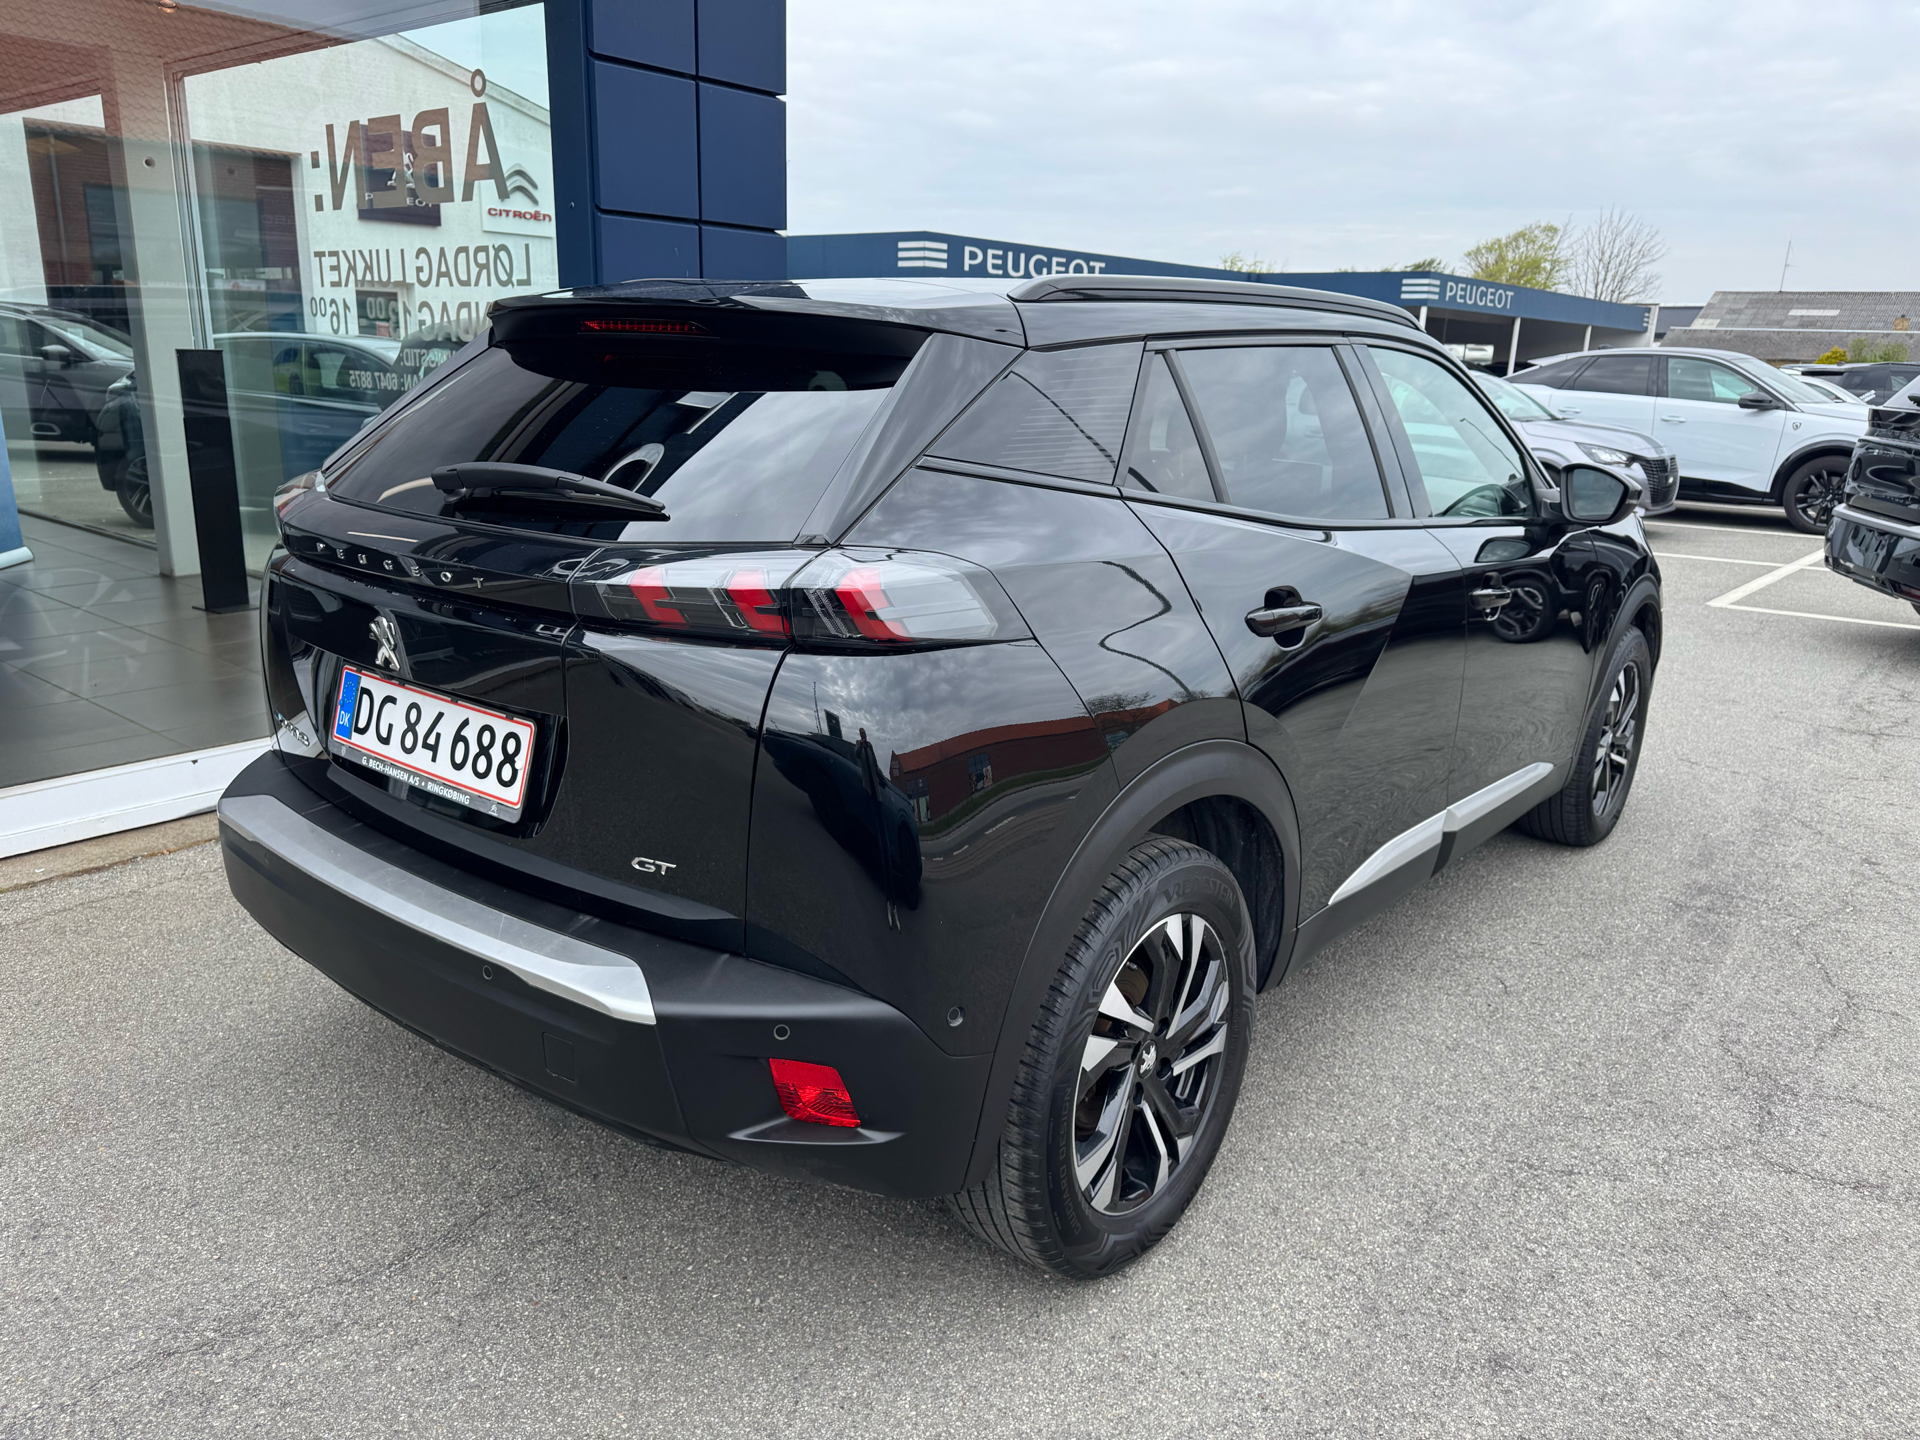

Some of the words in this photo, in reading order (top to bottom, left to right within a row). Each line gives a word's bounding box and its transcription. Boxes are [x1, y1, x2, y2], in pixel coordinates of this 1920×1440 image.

[963, 245, 1106, 278] PEUGEOT
[1445, 281, 1515, 309] PEUGEOT
[316, 542, 484, 589] PEUGEOT
[339, 710, 351, 728] DK
[353, 686, 398, 746] DG
[400, 702, 445, 763] 84
[449, 717, 522, 788] 688
[368, 759, 409, 781] BECH-HANSEN
[409, 774, 420, 786] A/S
[426, 781, 471, 804] RINGKØBING
[631, 856, 677, 876] GT
